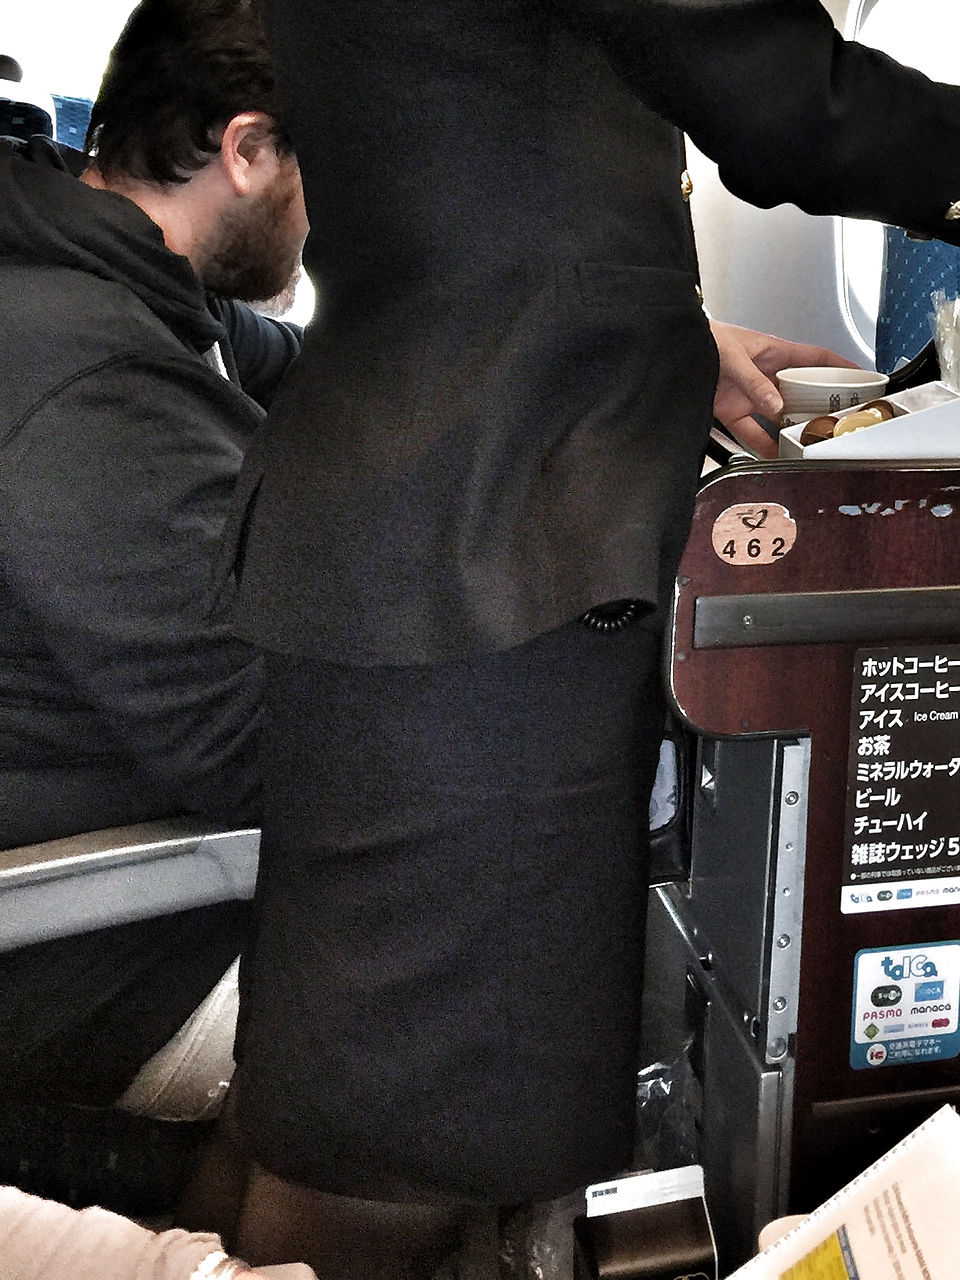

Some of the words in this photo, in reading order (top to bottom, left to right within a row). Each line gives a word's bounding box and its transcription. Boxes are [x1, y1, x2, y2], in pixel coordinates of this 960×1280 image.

[722, 537, 785, 558] 462
[859, 709, 904, 730] アイス
[914, 711, 928, 722] Ice
[929, 710, 959, 721] Cream
[858, 734, 891, 756] お茶
[856, 787, 902, 809] ビール
[853, 811, 928, 835] チューハイ
[863, 1008, 903, 1021] PASMO
[911, 1003, 951, 1015] manaca
